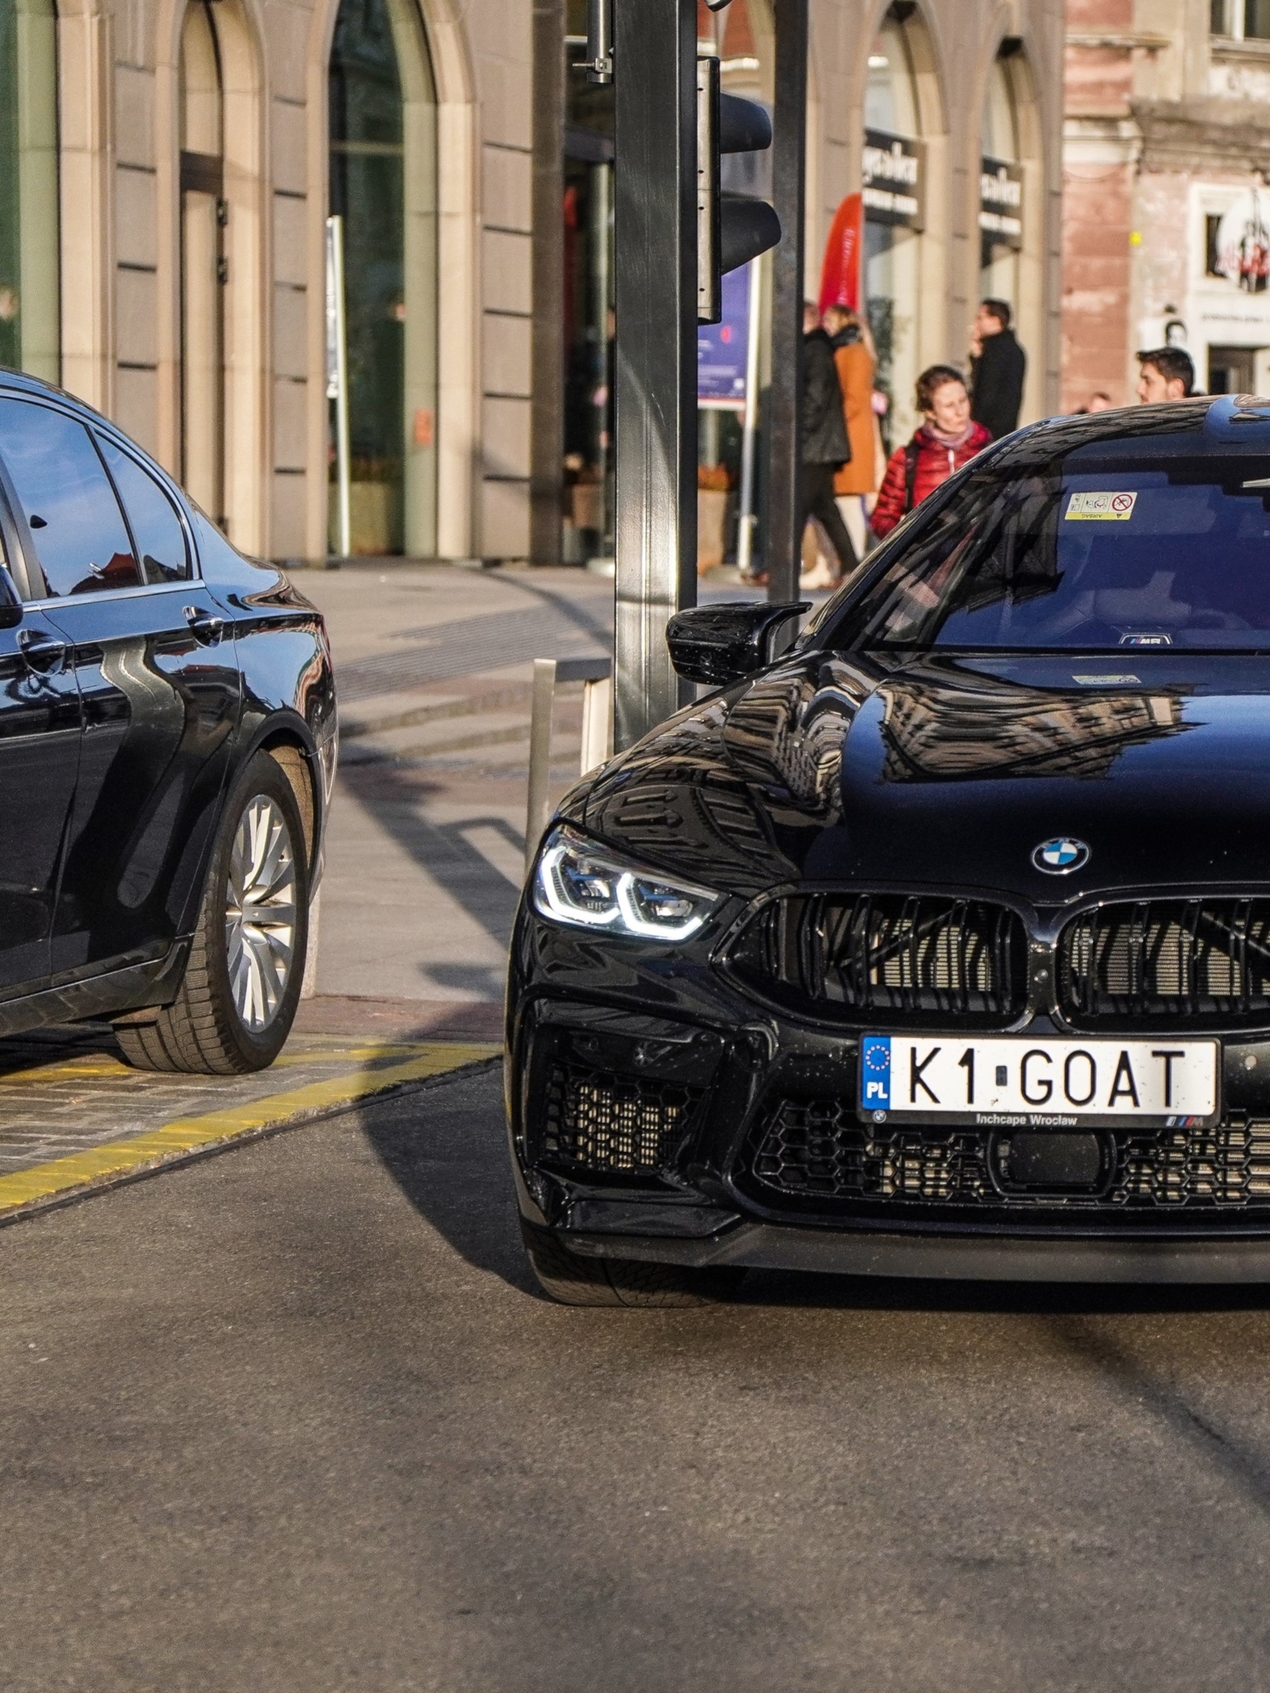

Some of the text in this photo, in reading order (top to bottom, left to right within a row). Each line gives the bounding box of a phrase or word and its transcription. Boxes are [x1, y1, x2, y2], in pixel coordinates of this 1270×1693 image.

[910, 1046, 1186, 1108] K1 GOAT
[866, 1081, 888, 1099] PL
[976, 1113, 1027, 1126] Inchcape
